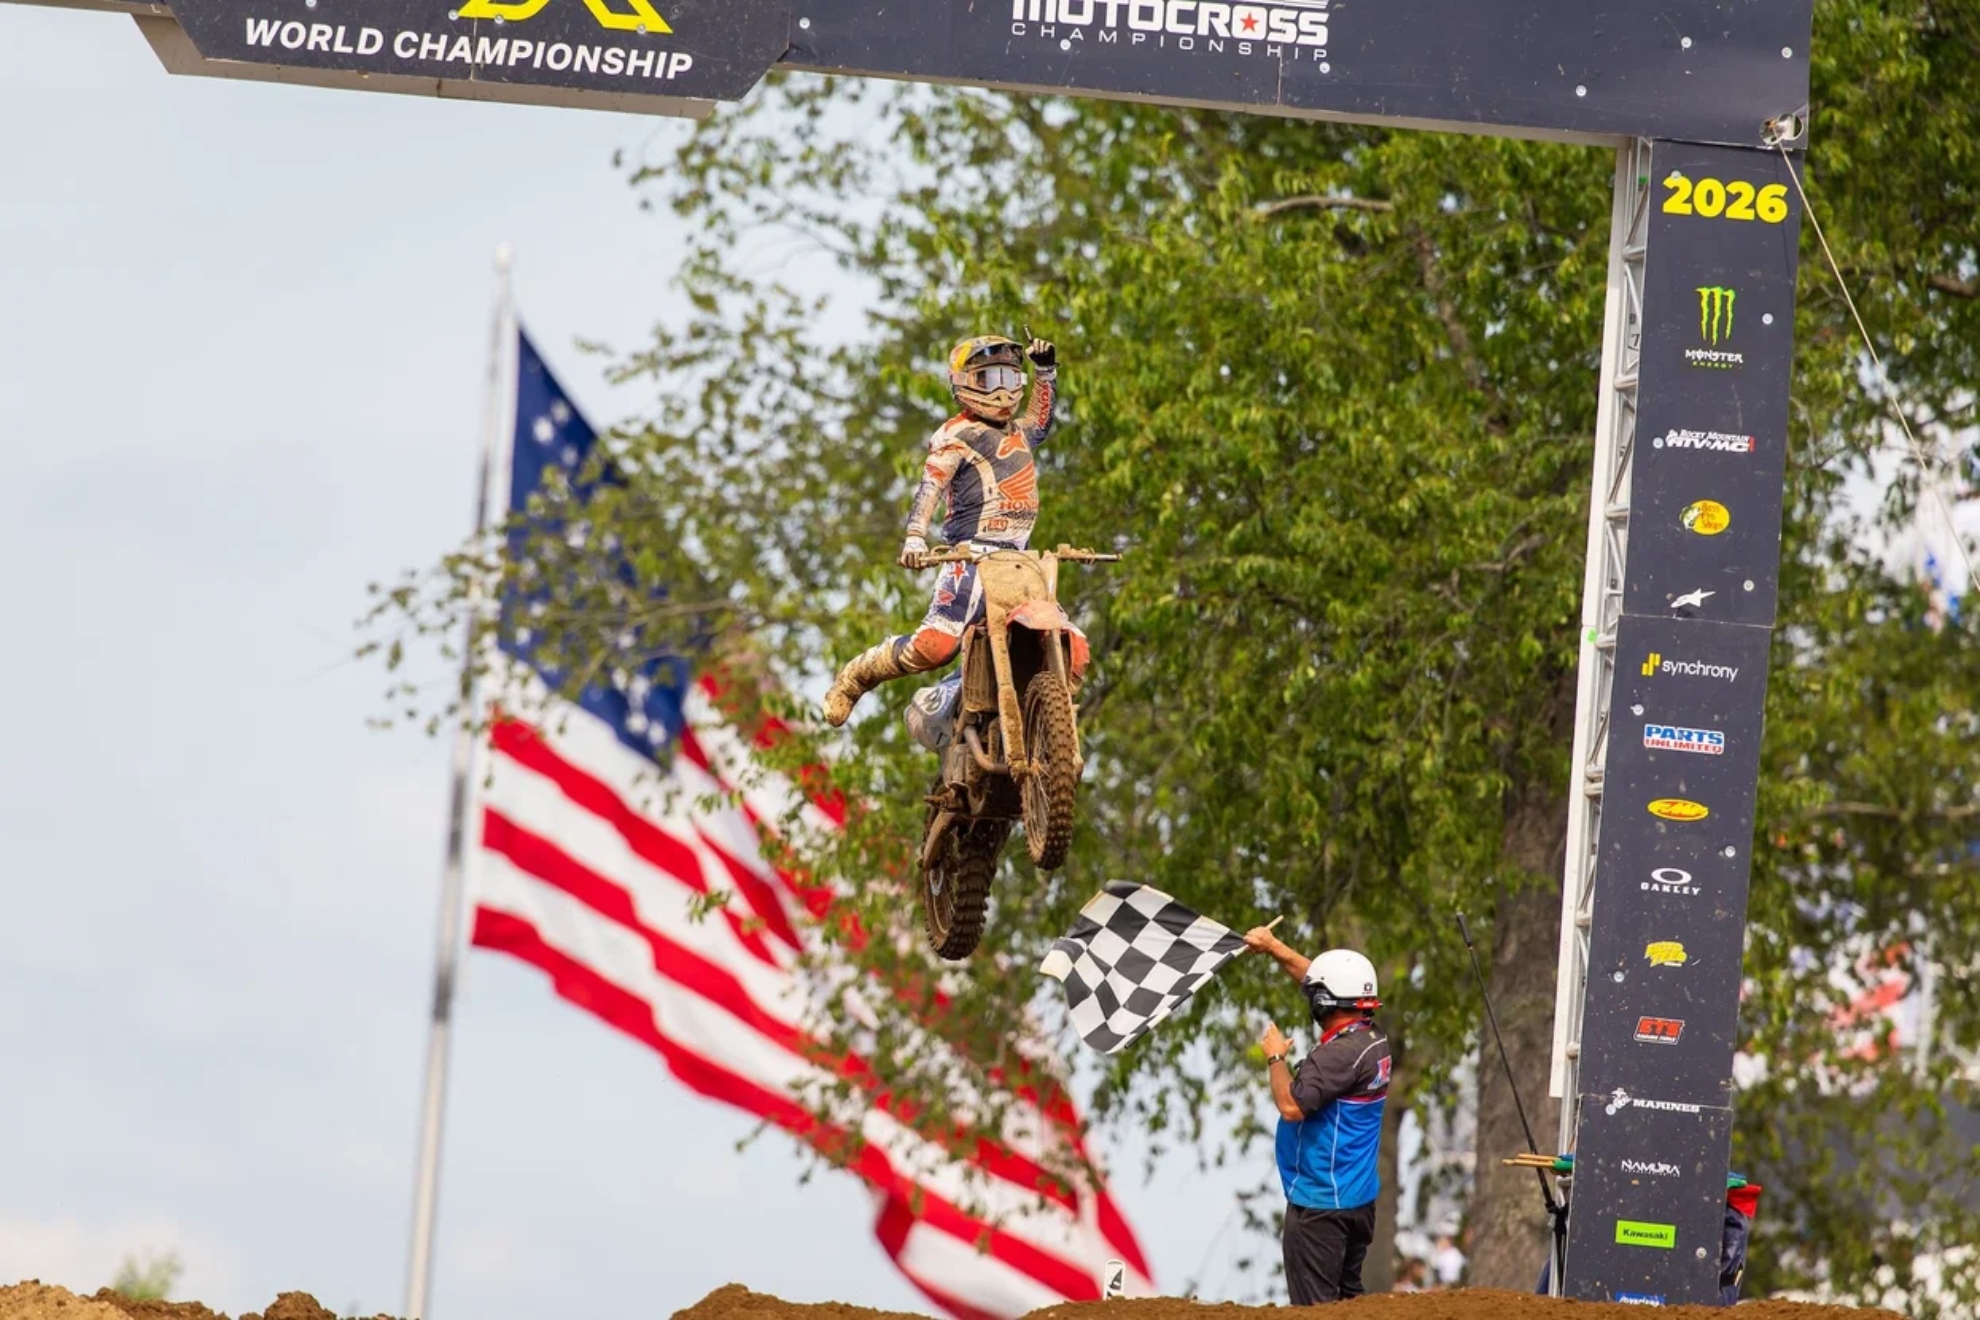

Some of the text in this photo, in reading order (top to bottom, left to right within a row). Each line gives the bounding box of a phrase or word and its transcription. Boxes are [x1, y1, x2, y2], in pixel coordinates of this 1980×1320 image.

[1012, 0, 1330, 46] MOTOCROSS
[245, 18, 693, 80] WORLD CHAMPIONSHIP
[1012, 23, 1328, 61] CHAMPIONSHIP
[1662, 175, 1789, 223] 2026
[1685, 348, 1743, 364] MONSTER
[1662, 660, 1738, 683] synchrony
[1646, 726, 1723, 745] PARTS
[1645, 739, 1722, 753] UNLIMITED
[1640, 882, 1701, 896] OAKLEY
[1632, 1099, 1700, 1113] MARINES
[1621, 1159, 1680, 1177] NAMURA
[1623, 1228, 1668, 1240] Kawasaki
